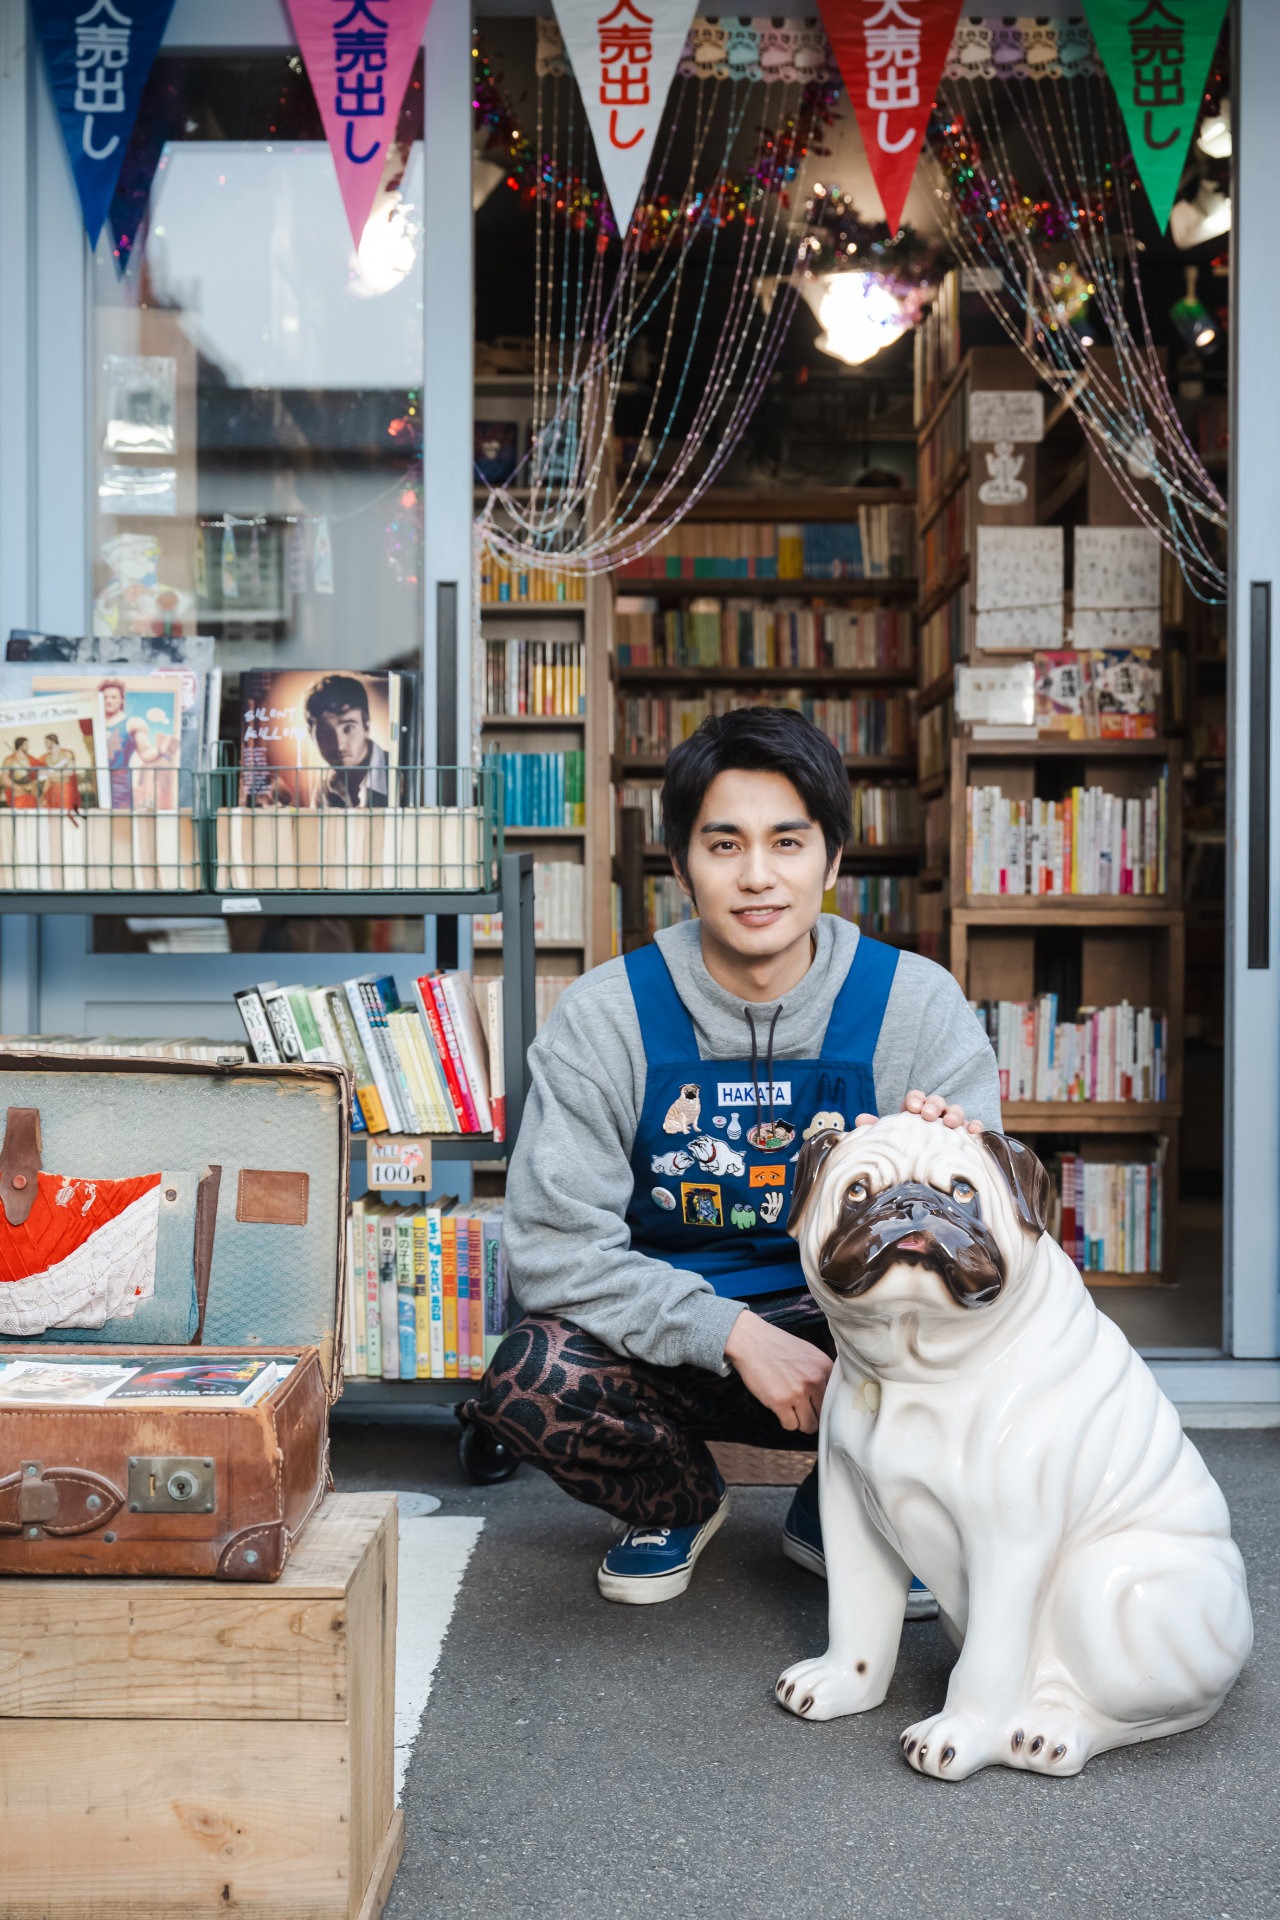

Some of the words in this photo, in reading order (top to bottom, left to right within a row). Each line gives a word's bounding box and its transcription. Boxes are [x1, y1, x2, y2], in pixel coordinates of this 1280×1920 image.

[332, 0, 389, 164] 大売出し
[863, 0, 922, 155] 大売出し
[1127, 0, 1185, 150] 大売出し
[722, 1086, 786, 1103] HAKATA
